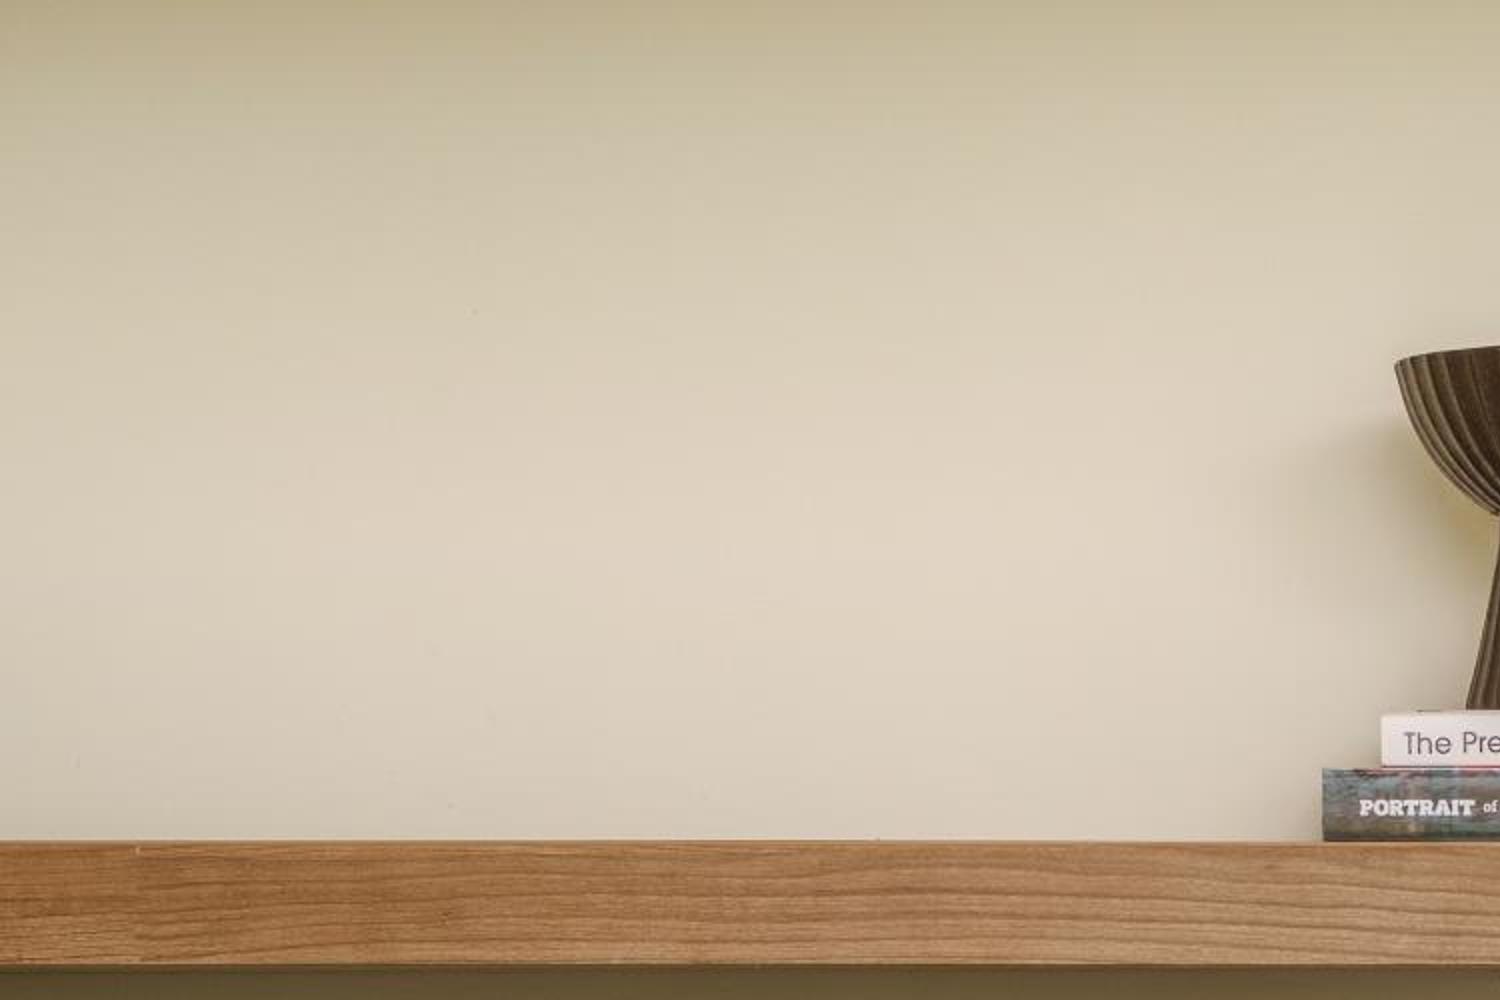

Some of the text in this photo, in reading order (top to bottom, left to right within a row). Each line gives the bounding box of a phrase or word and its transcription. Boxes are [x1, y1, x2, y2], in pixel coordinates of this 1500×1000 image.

[1404, 731, 1452, 755] The
[1359, 799, 1476, 817] PORTRAIT
[1483, 799, 1499, 813] of
